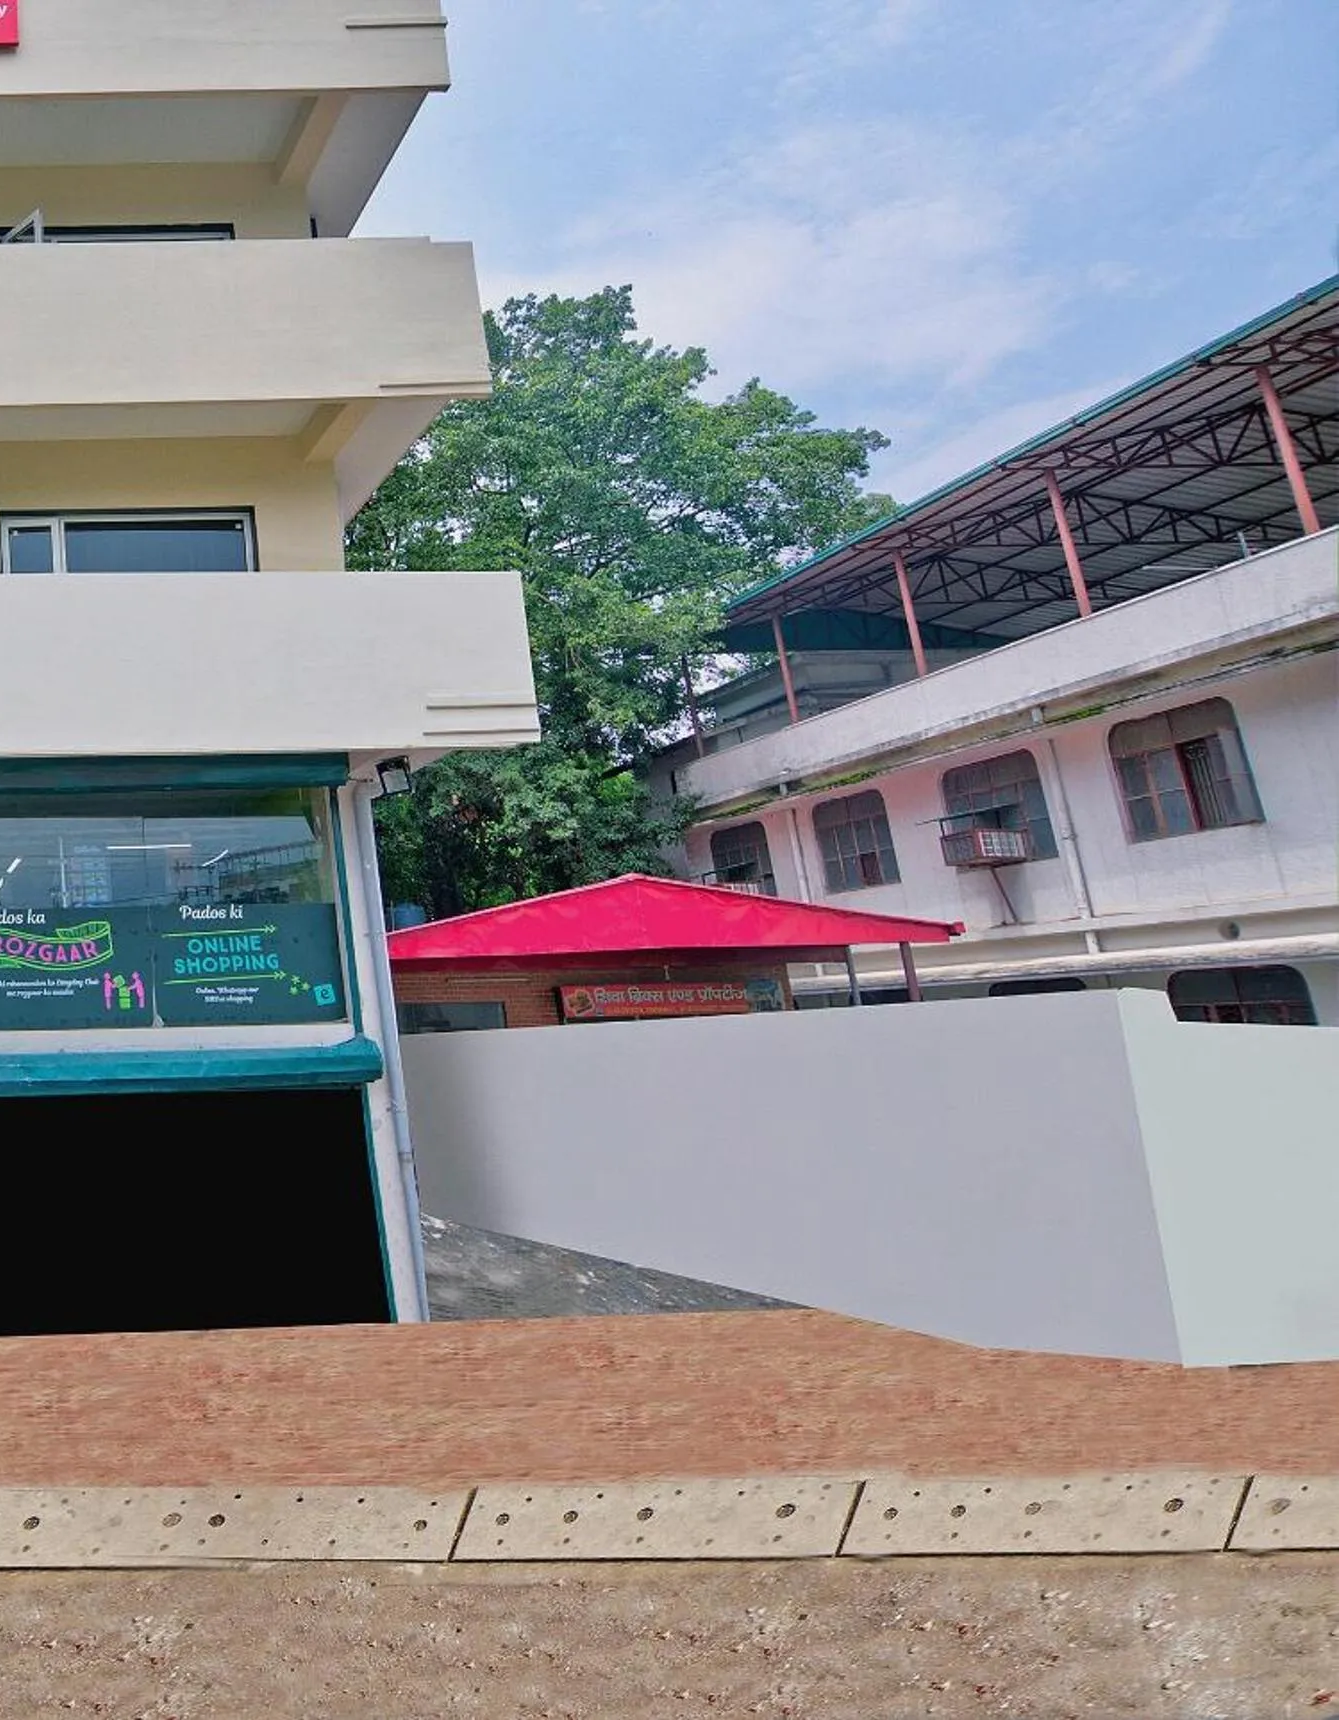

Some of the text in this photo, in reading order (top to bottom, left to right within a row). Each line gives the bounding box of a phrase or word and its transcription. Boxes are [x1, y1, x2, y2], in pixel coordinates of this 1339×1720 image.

[27, 908, 47, 925] ka
[178, 903, 244, 919] Pados ki
[187, 935, 262, 954] ONLINE
[174, 953, 279, 974] SHOPPING
